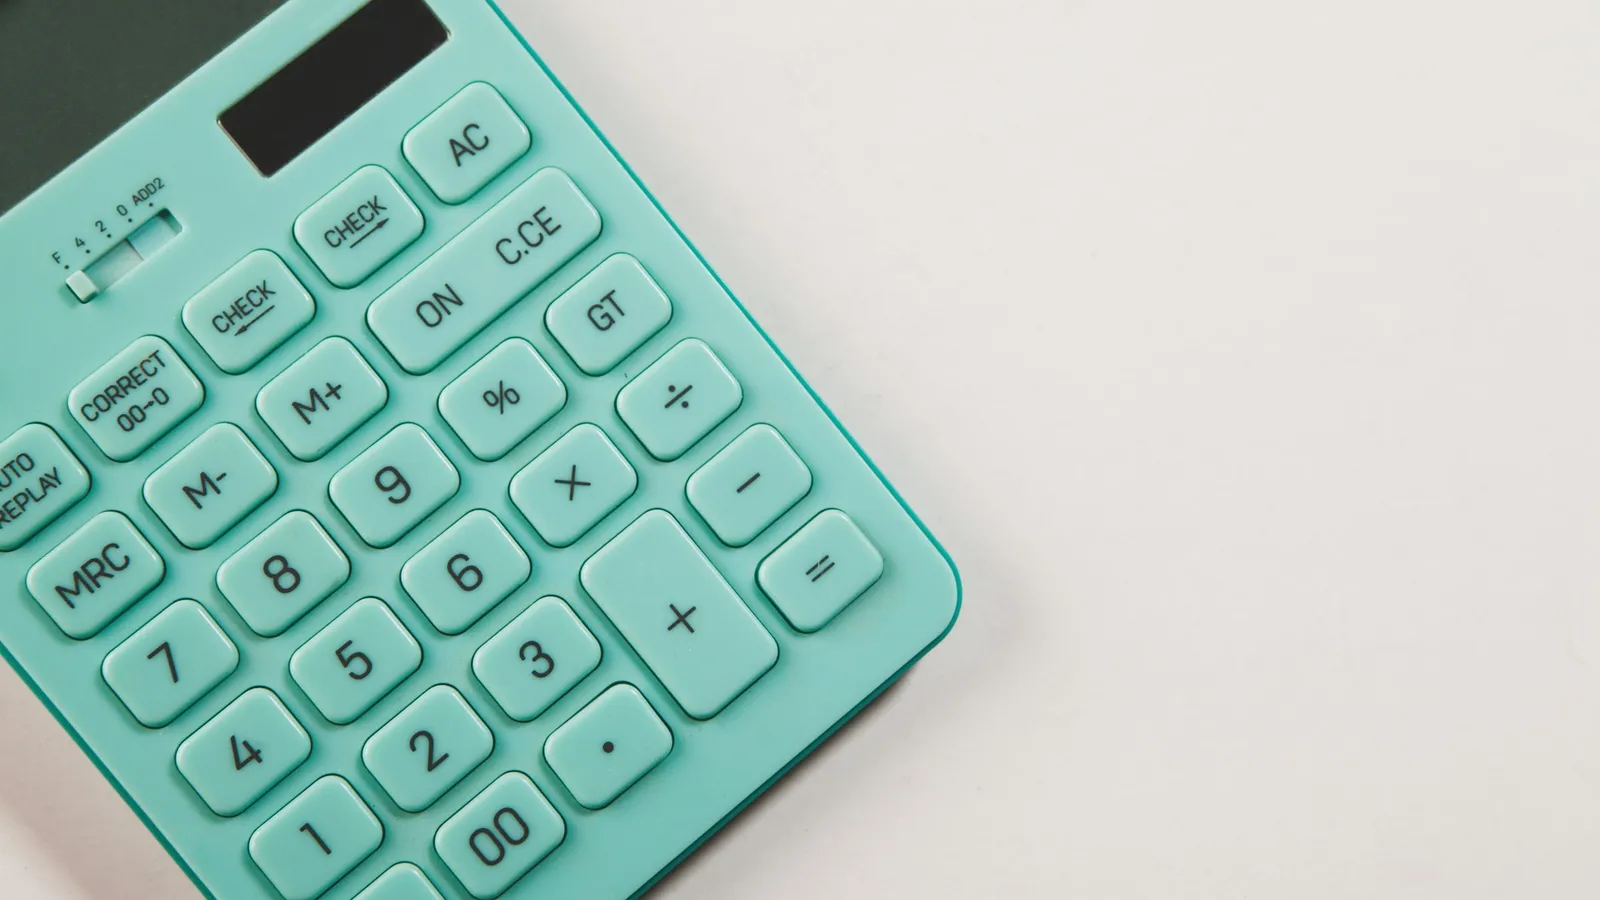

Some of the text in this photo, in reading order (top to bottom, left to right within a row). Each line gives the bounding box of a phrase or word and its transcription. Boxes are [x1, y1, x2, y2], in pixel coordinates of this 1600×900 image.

[449, 123, 490, 168] AC
[51, 251, 62, 264] F
[74, 236, 86, 248] 4
[94, 219, 108, 233] 2
[131, 176, 166, 207] ADD2
[323, 195, 389, 249] CHECK
[414, 206, 563, 329] ON C.CE
[211, 279, 277, 335] CHECK
[587, 289, 626, 333] GT
[80, 349, 167, 423] CORRECT
[291, 382, 343, 426] M+
[482, 380, 521, 415] %
[0, 452, 36, 490] UTO
[182, 471, 228, 511] M-
[374, 465, 412, 505] 9
[0, 466, 63, 530] REPLAY
[54, 542, 131, 610] MRC
[262, 554, 301, 594] 8
[446, 553, 484, 592] 6
[806, 554, 836, 583] =
[667, 603, 697, 634] +
[146, 641, 180, 684] 7
[335, 639, 373, 681] 5
[518, 640, 556, 679] 3
[228, 731, 263, 772] 4
[409, 730, 450, 773] 2
[299, 822, 332, 856] 1
[468, 806, 530, 867] 00
